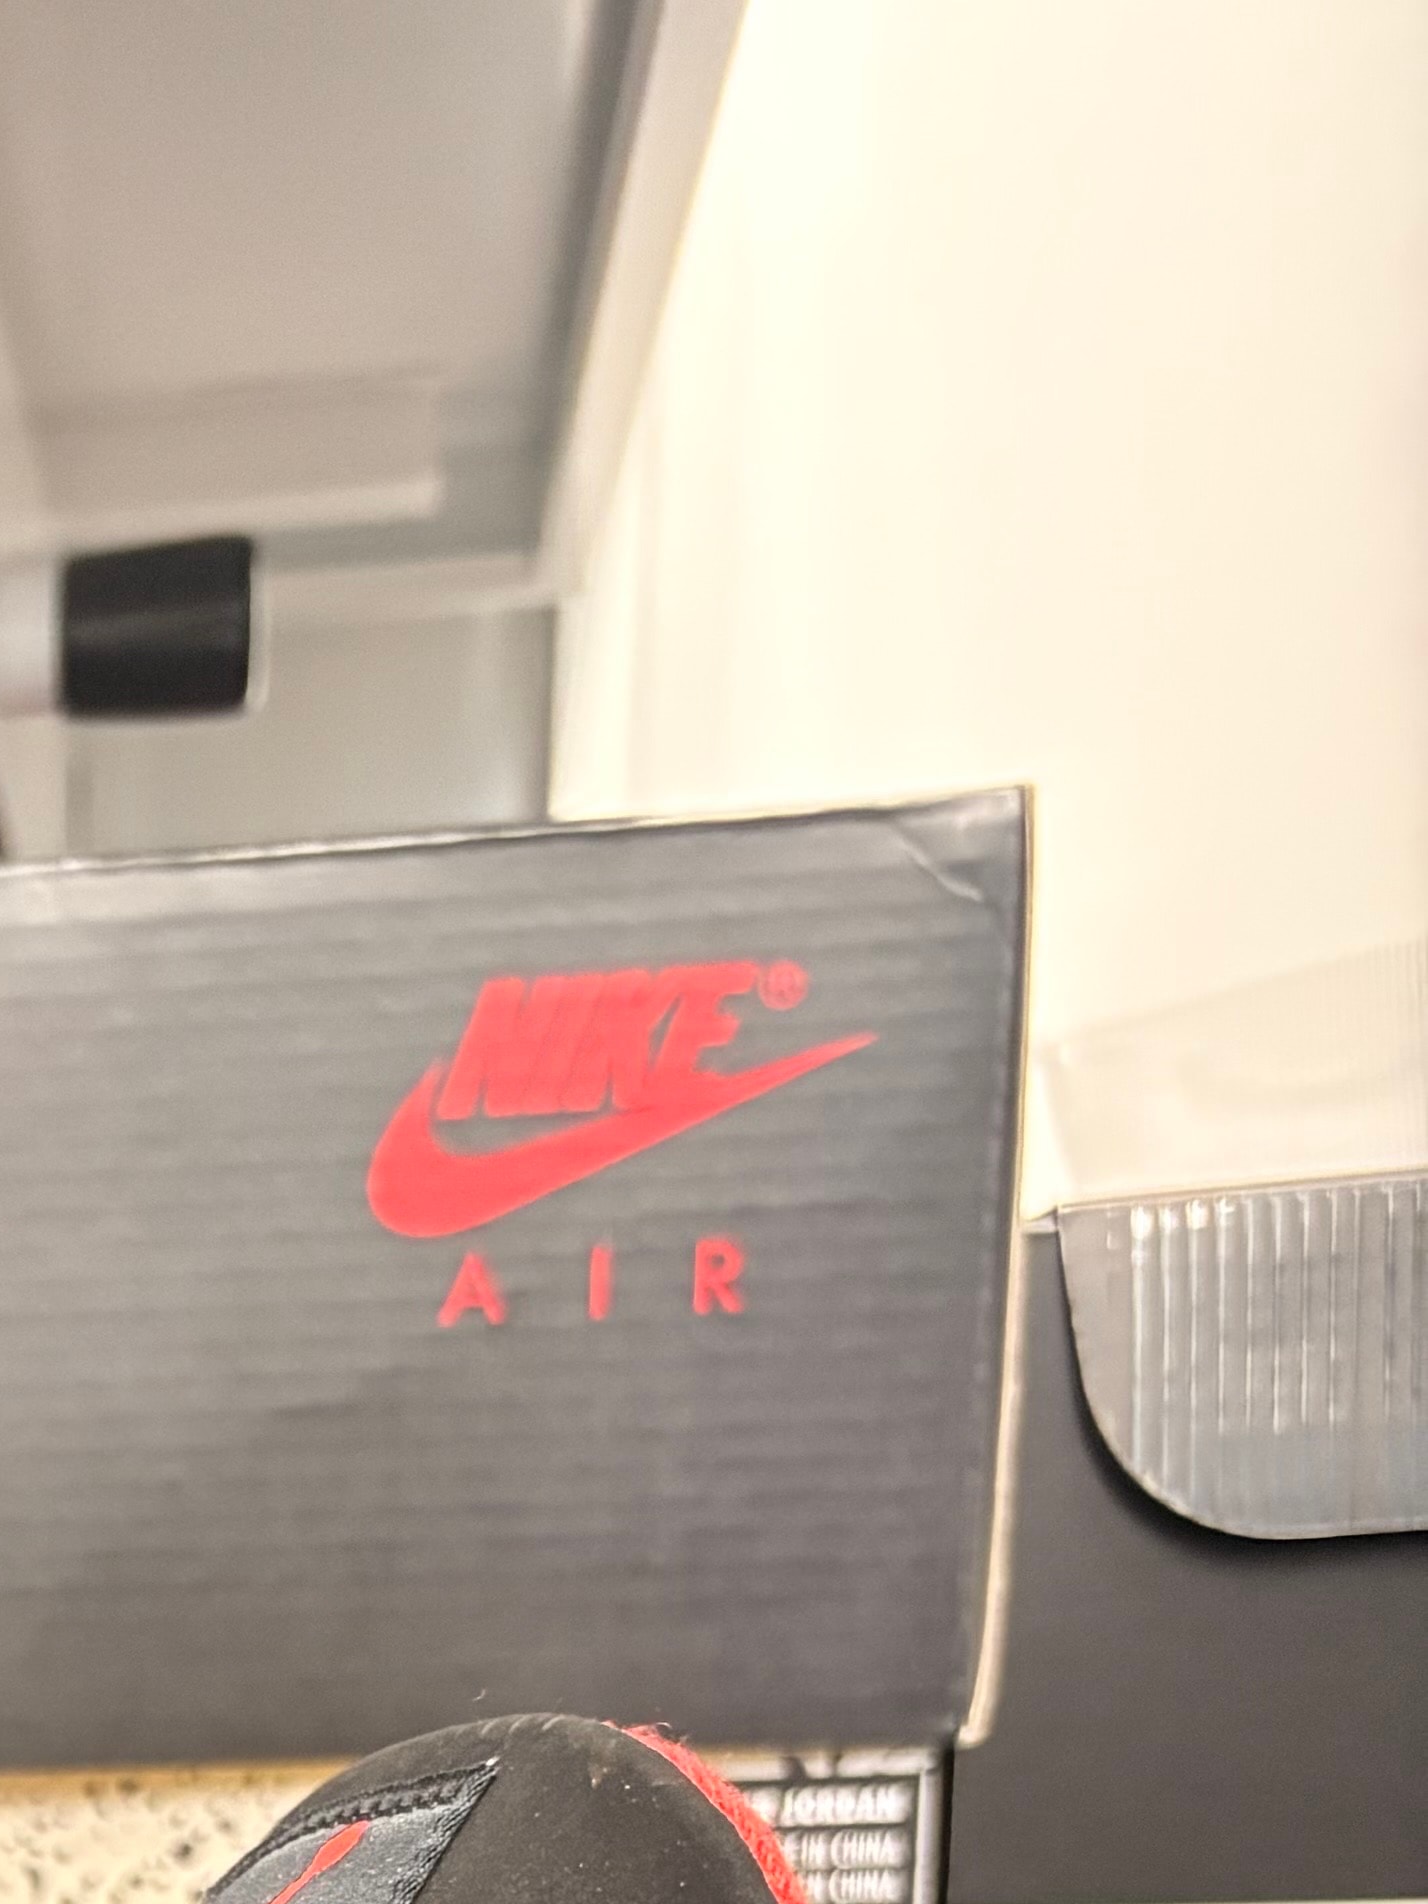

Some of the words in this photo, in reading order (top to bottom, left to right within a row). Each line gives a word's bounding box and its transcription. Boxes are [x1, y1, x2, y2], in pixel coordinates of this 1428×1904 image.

[436, 960, 757, 1120] NIKE
[436, 1236, 746, 1328] AIR
[780, 1784, 912, 1827] JORDAN
[830, 1829, 908, 1868] CHINA
